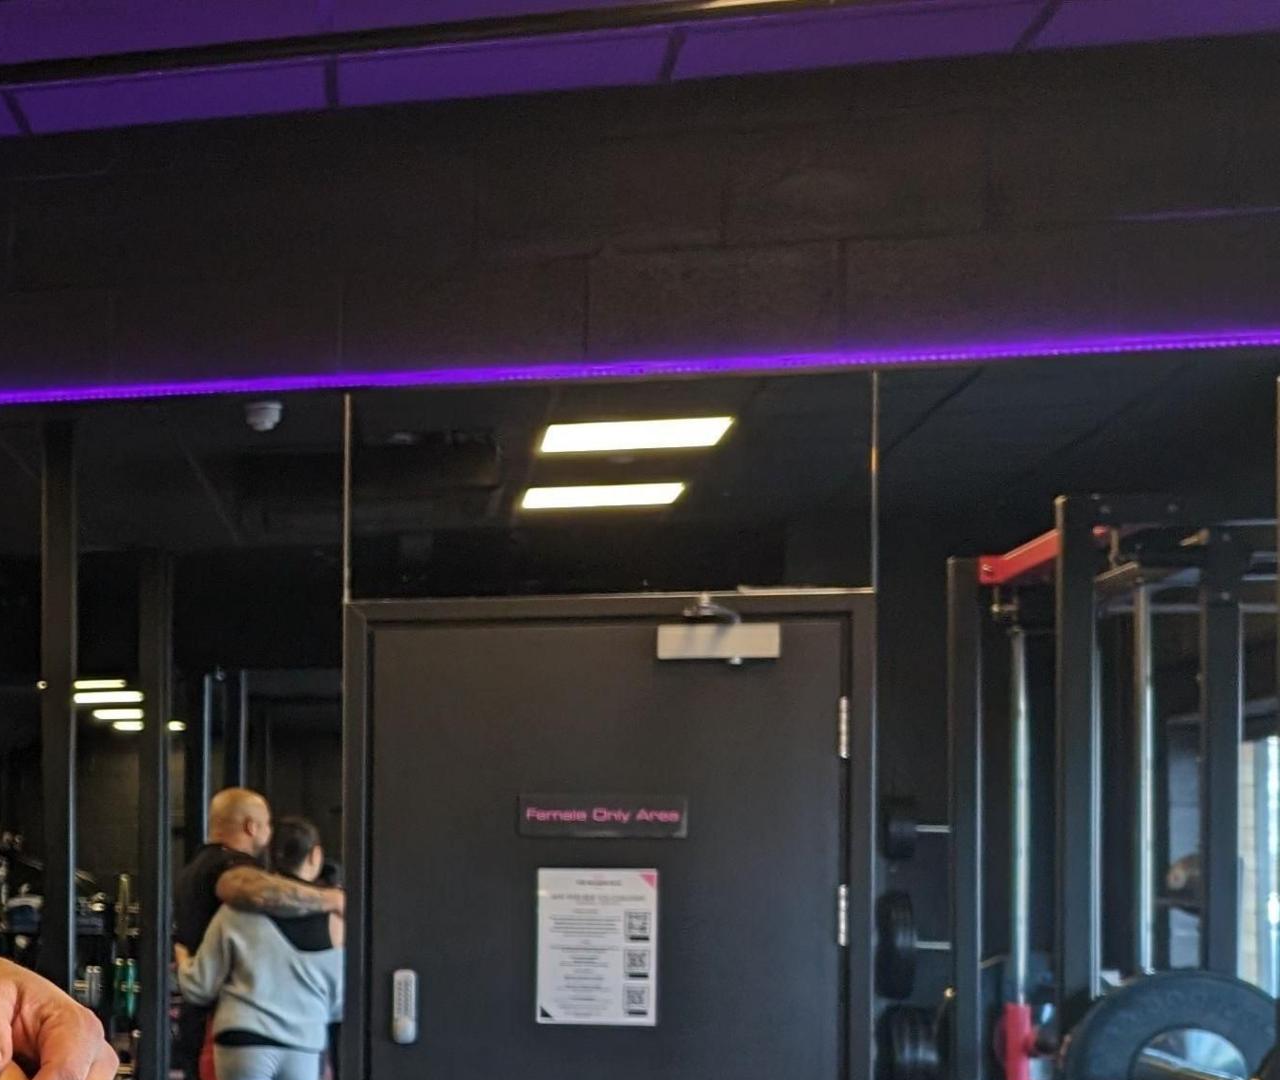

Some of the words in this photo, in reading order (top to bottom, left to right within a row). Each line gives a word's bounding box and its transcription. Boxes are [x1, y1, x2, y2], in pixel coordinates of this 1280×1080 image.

[525, 807, 587, 822] Female
[592, 807, 630, 824] Only
[636, 808, 680, 822] Area
